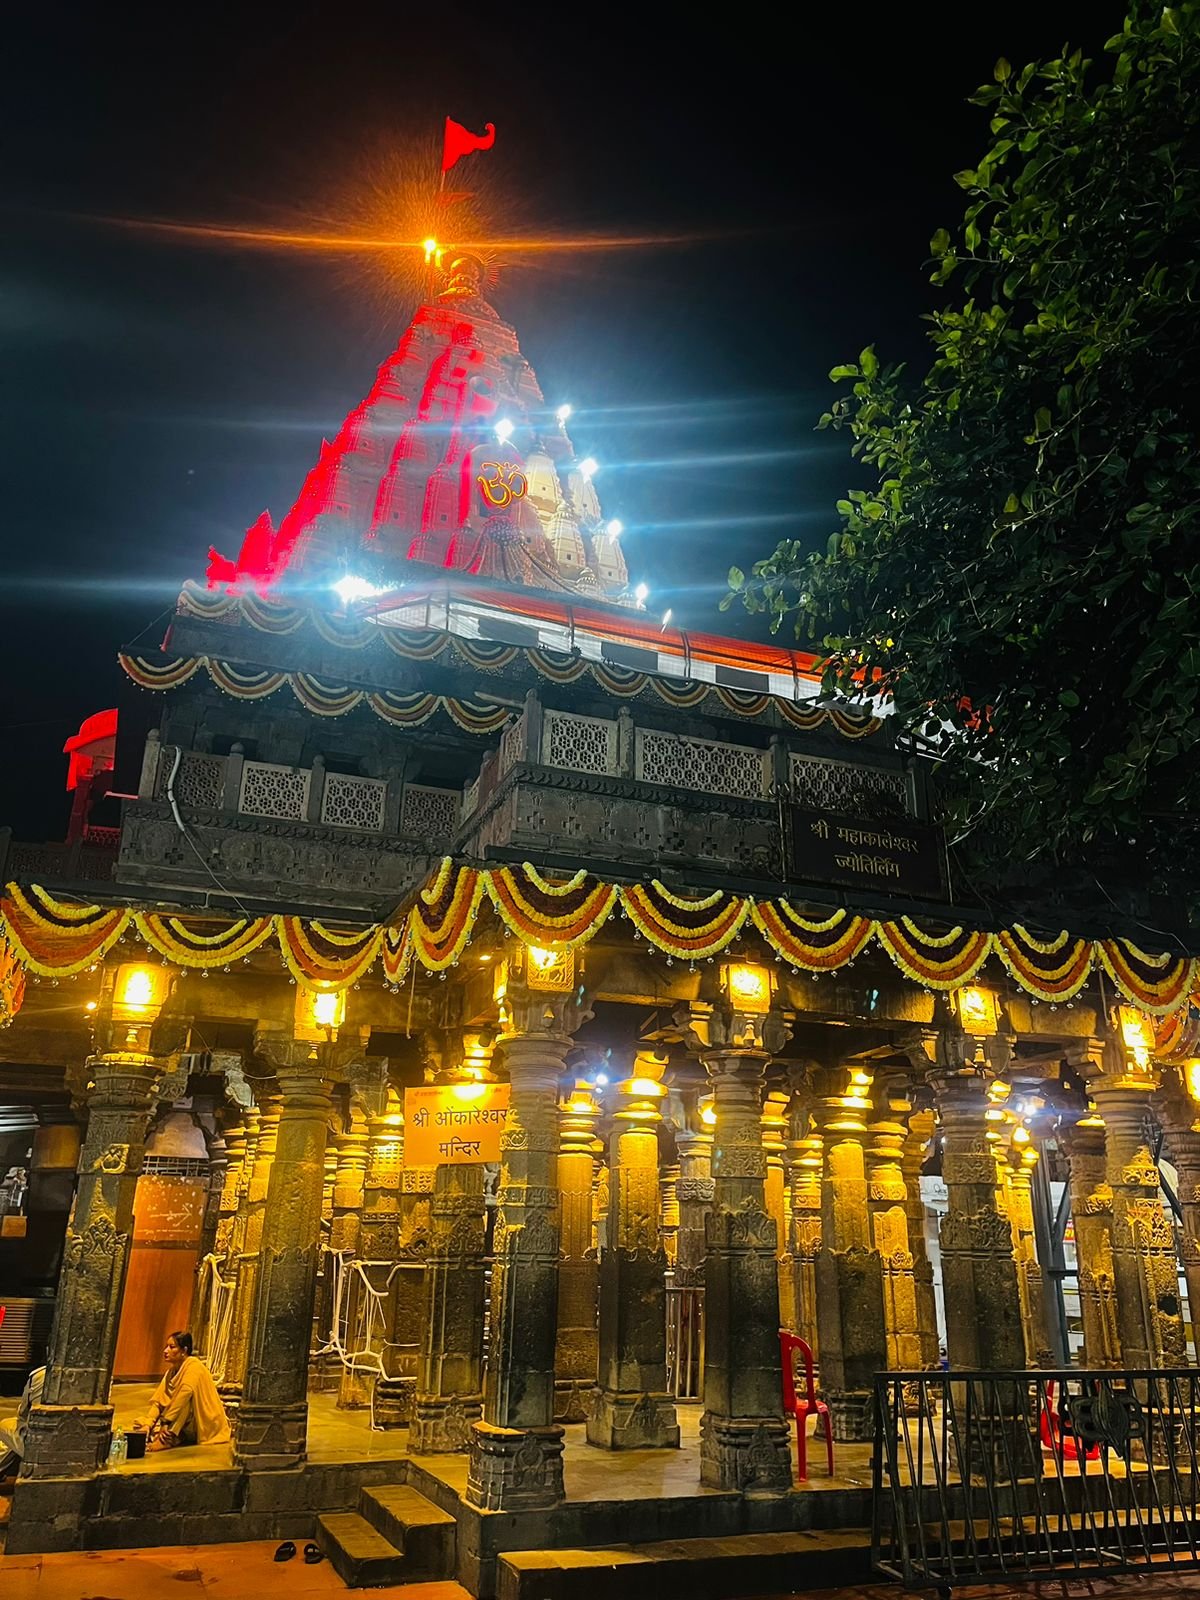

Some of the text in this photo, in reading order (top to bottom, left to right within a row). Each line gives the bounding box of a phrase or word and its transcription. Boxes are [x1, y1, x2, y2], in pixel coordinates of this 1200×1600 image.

[810, 819, 919, 853] श्री महाकालेश्वर
[413, 1105, 508, 1127] श्री ओंकारेश्वर
[439, 1136, 481, 1157] मन्दिर
